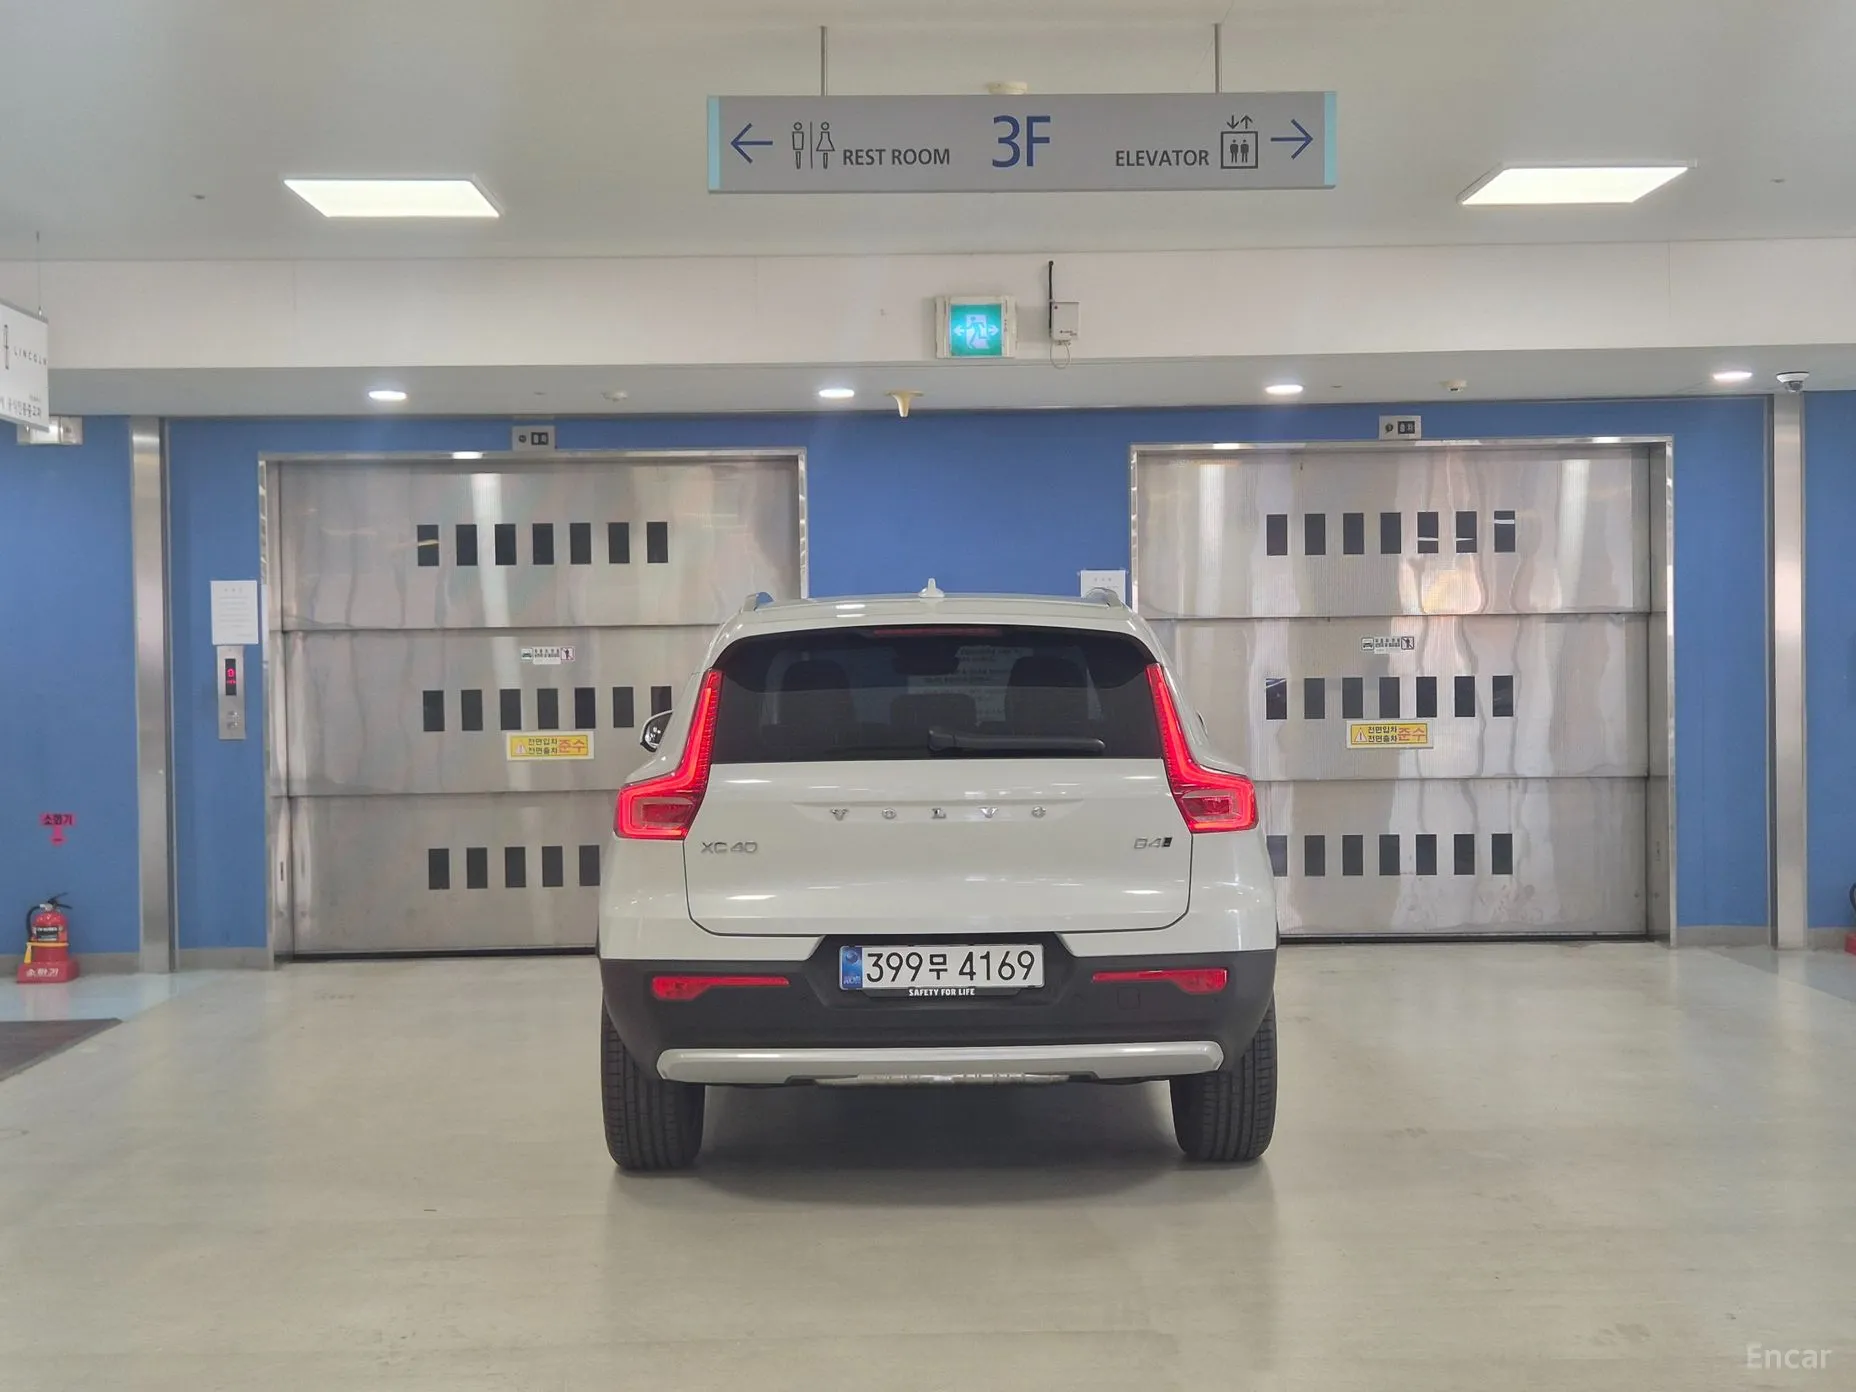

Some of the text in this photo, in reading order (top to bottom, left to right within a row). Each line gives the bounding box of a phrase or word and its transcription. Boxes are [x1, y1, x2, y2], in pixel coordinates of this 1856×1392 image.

[991, 114, 1052, 168] 3F
[843, 148, 950, 166] REST ROOM
[1115, 148, 1210, 168] ELEVATOR
[43, 813, 73, 826] 소화기
[830, 805, 1047, 821] VOLVO
[701, 841, 758, 854] XC 40
[866, 950, 1035, 983] 399무 4169
[908, 988, 976, 997] SAFETY FOR LIFE
